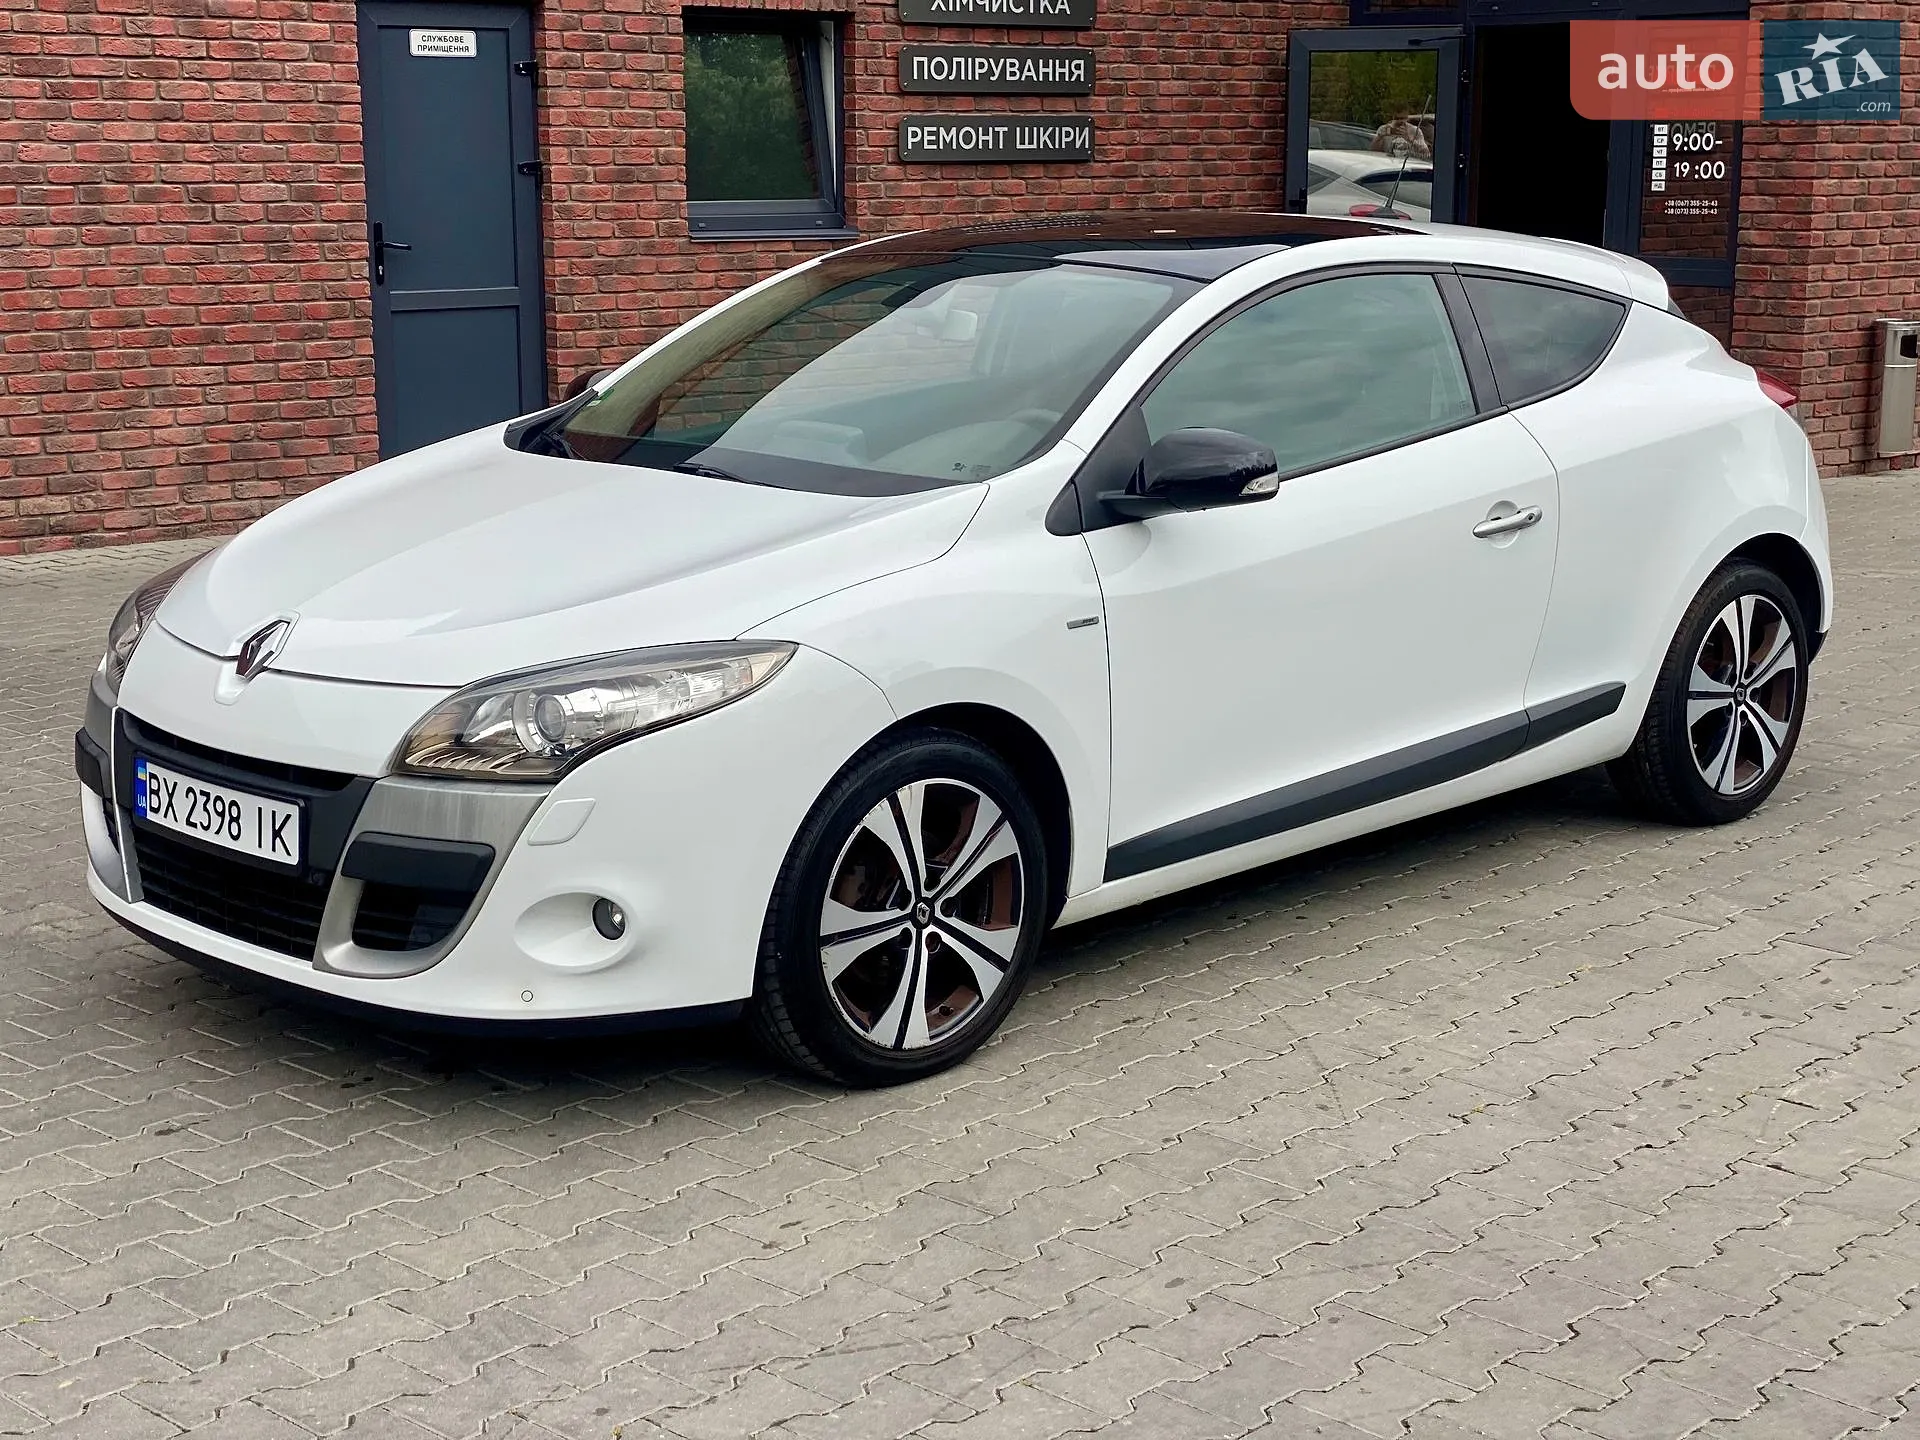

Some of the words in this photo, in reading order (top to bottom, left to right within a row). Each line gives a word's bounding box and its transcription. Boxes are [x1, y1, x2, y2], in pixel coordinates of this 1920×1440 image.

[421, 34, 465, 44] СЛУЖБОВЕ
[417, 45, 470, 54] ПРИМІЩЕННЯ
[912, 56, 1085, 82] ПОЛІРУВАННЯ
[906, 126, 1009, 150] РЕМОНТ
[1015, 126, 1090, 150] ШКІРИ
[1672, 132, 1723, 152] 9:00-
[137, 794, 147, 810] UA
[148, 771, 178, 823] BX
[185, 786, 241, 842] 2398
[257, 806, 293, 857] IK
